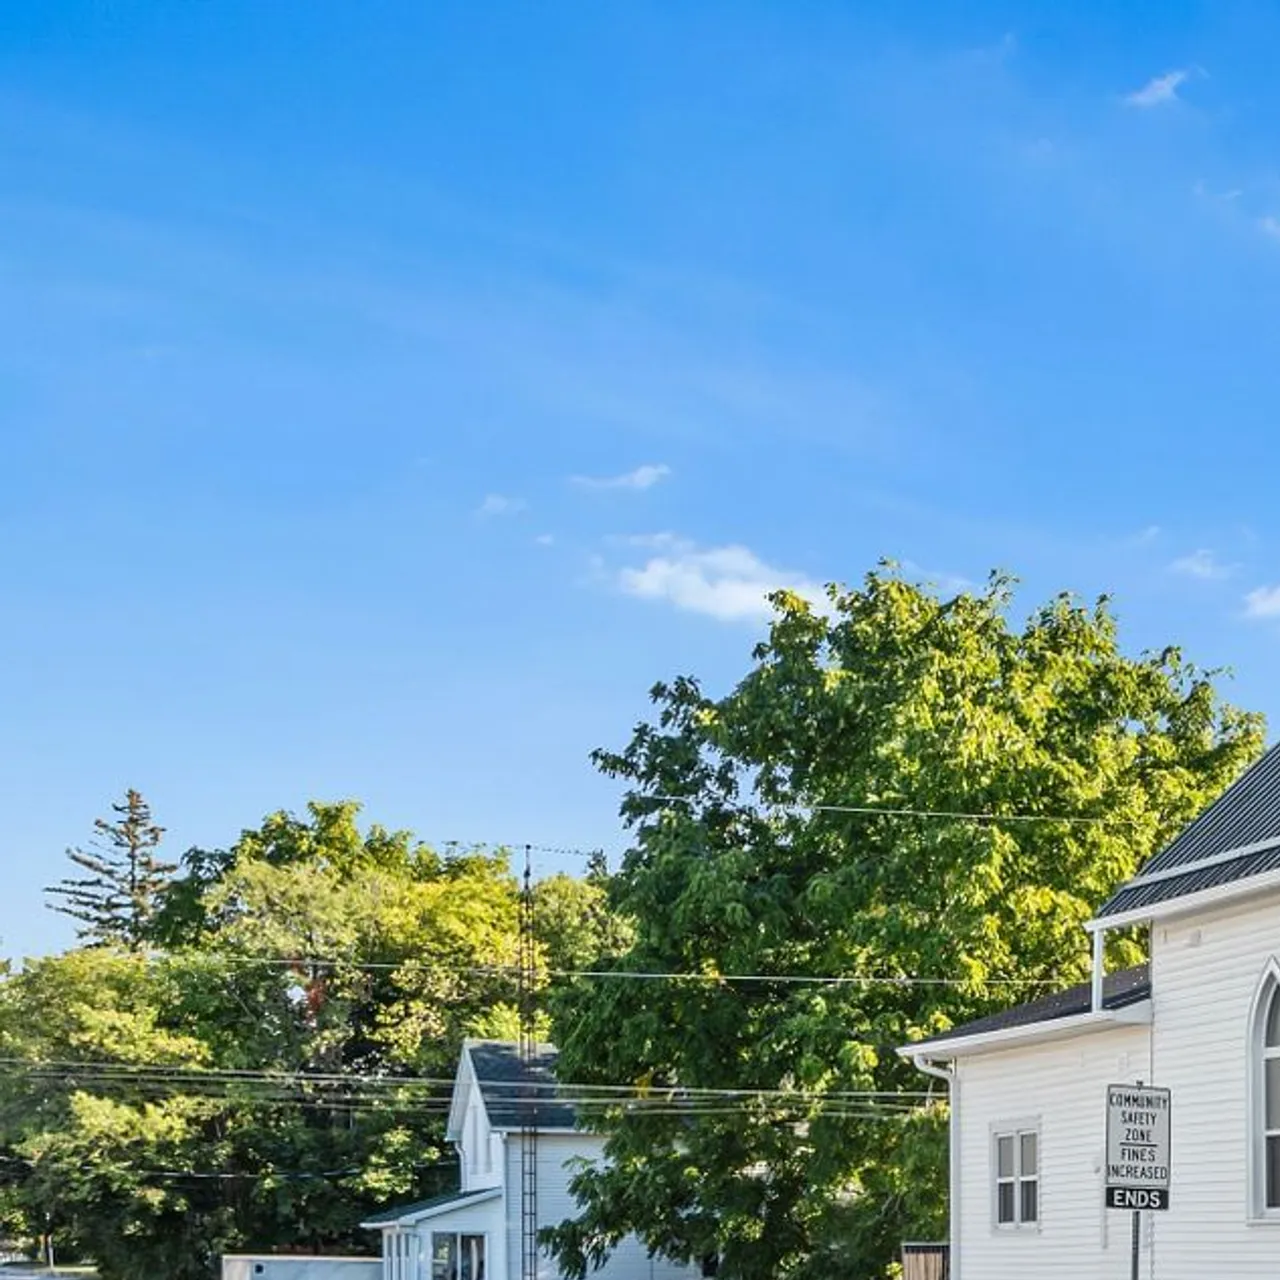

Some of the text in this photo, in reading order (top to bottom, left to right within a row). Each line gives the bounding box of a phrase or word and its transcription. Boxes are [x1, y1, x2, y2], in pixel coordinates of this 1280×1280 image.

[1109, 1093, 1167, 1109] COMMUNITY
[1120, 1110, 1157, 1126] SAFETY
[1125, 1128, 1152, 1142] ZONE
[1120, 1148, 1156, 1162] FINES
[1108, 1164, 1168, 1180] INCREASED
[1113, 1190, 1161, 1208] ENDS
